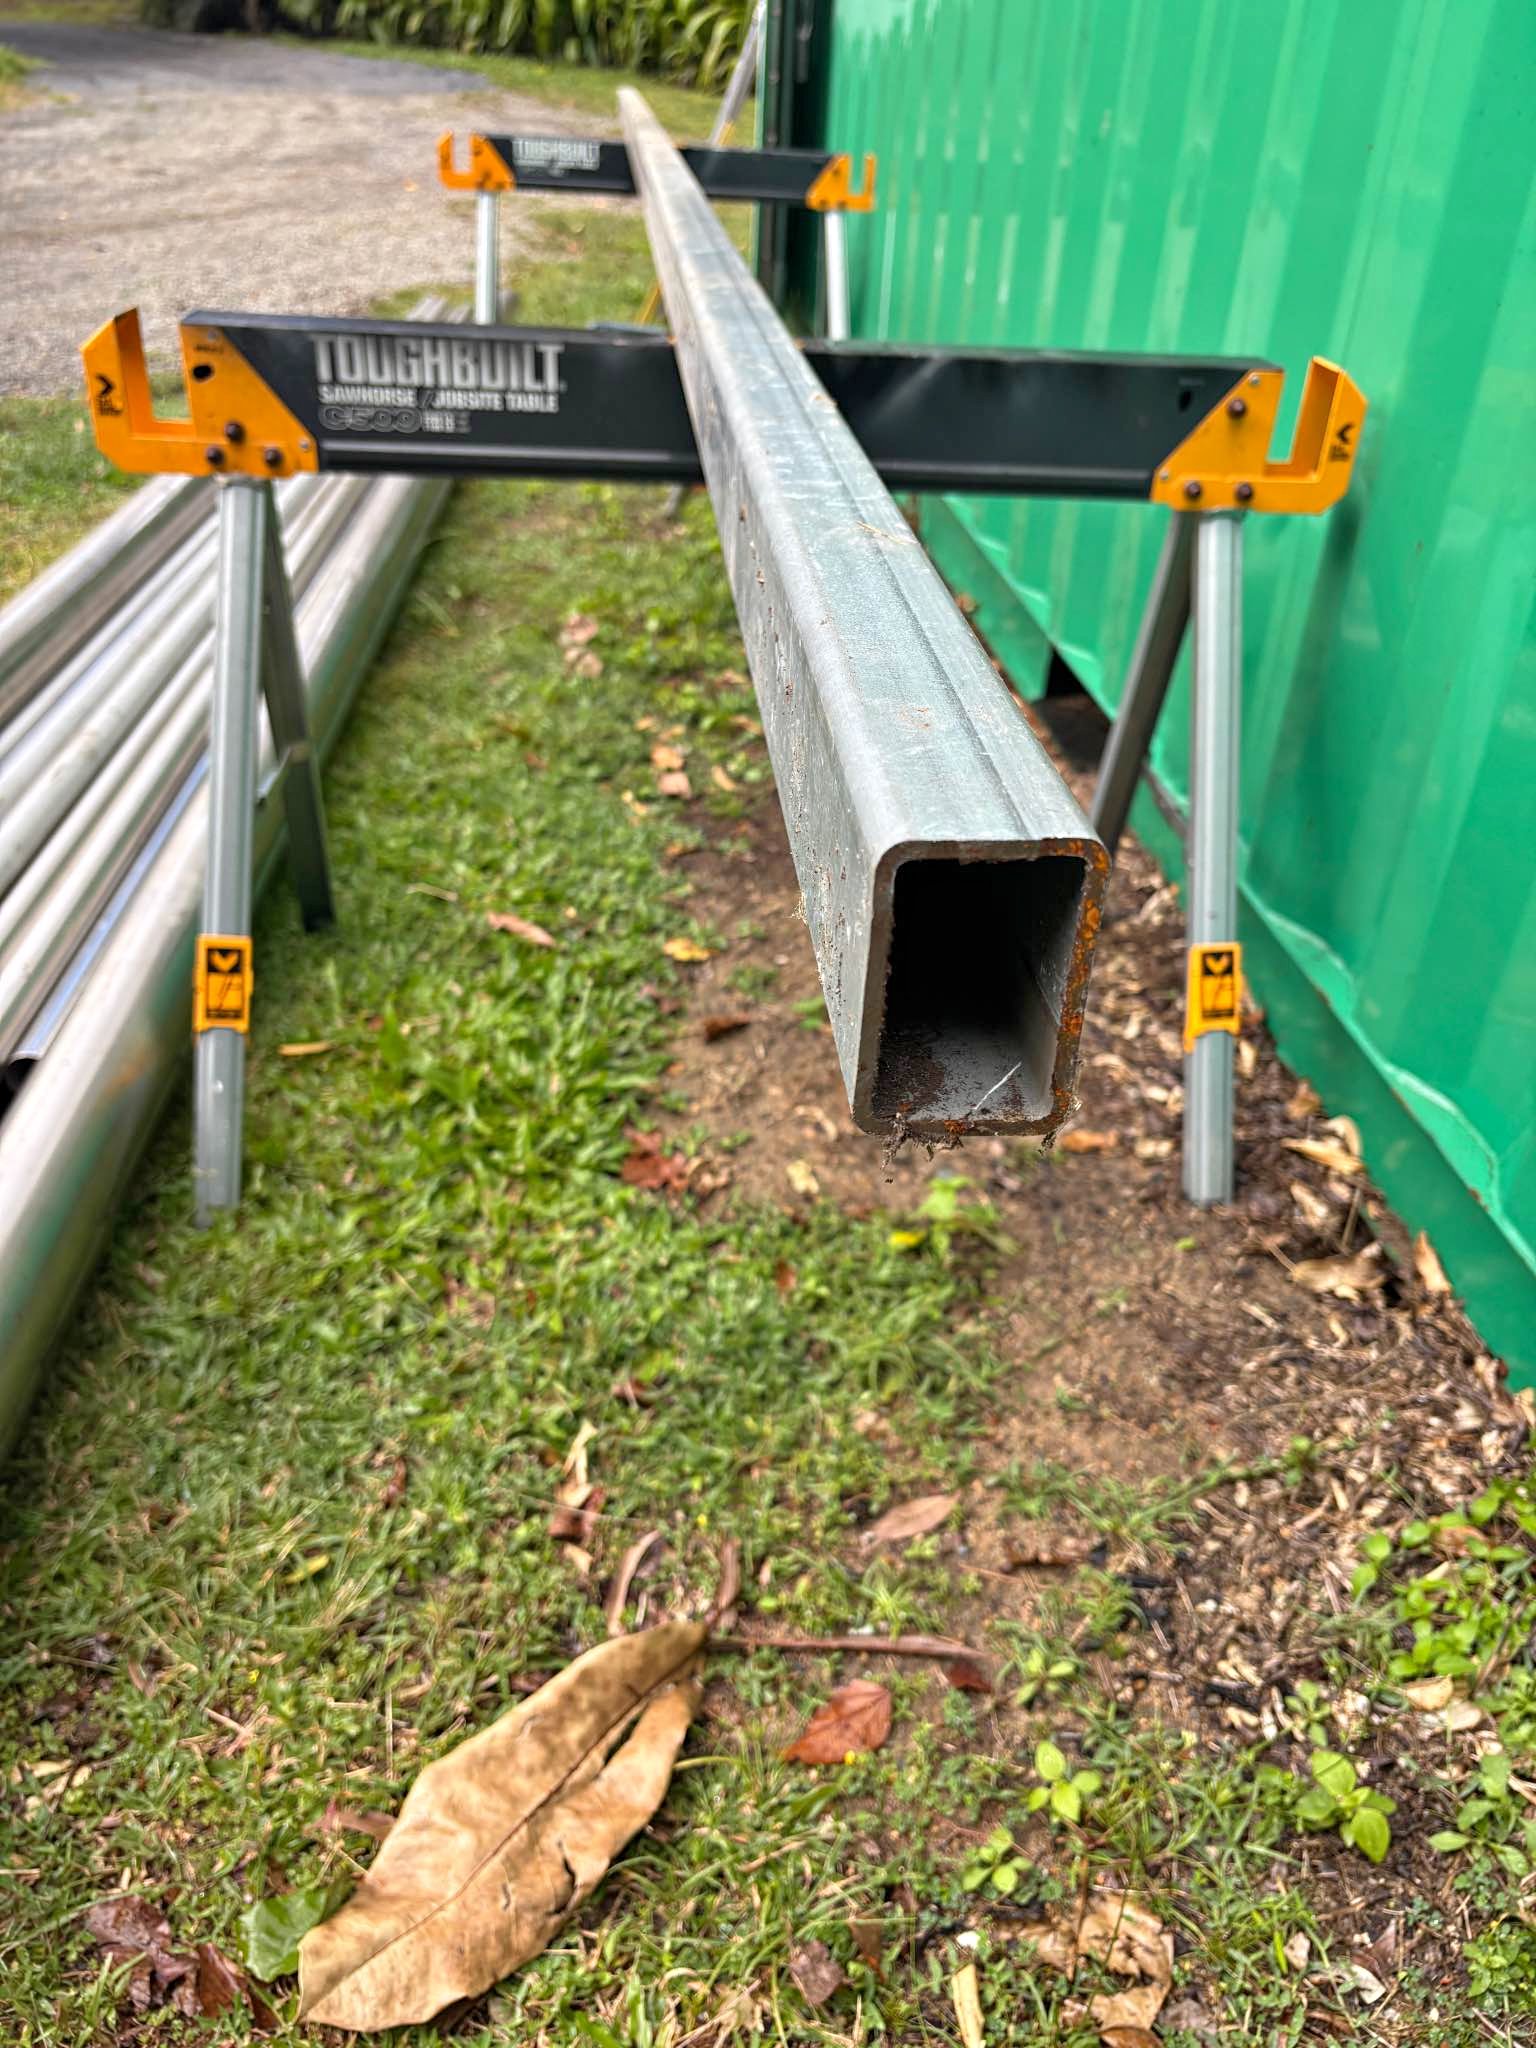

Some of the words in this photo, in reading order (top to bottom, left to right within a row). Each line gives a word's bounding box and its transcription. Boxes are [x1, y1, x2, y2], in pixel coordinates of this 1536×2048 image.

[313, 334, 564, 391] TOUGHBUILT
[319, 385, 417, 408] SAWHORSE
[432, 390, 504, 411] JOBSITE
[505, 392, 559, 413] TABLE
